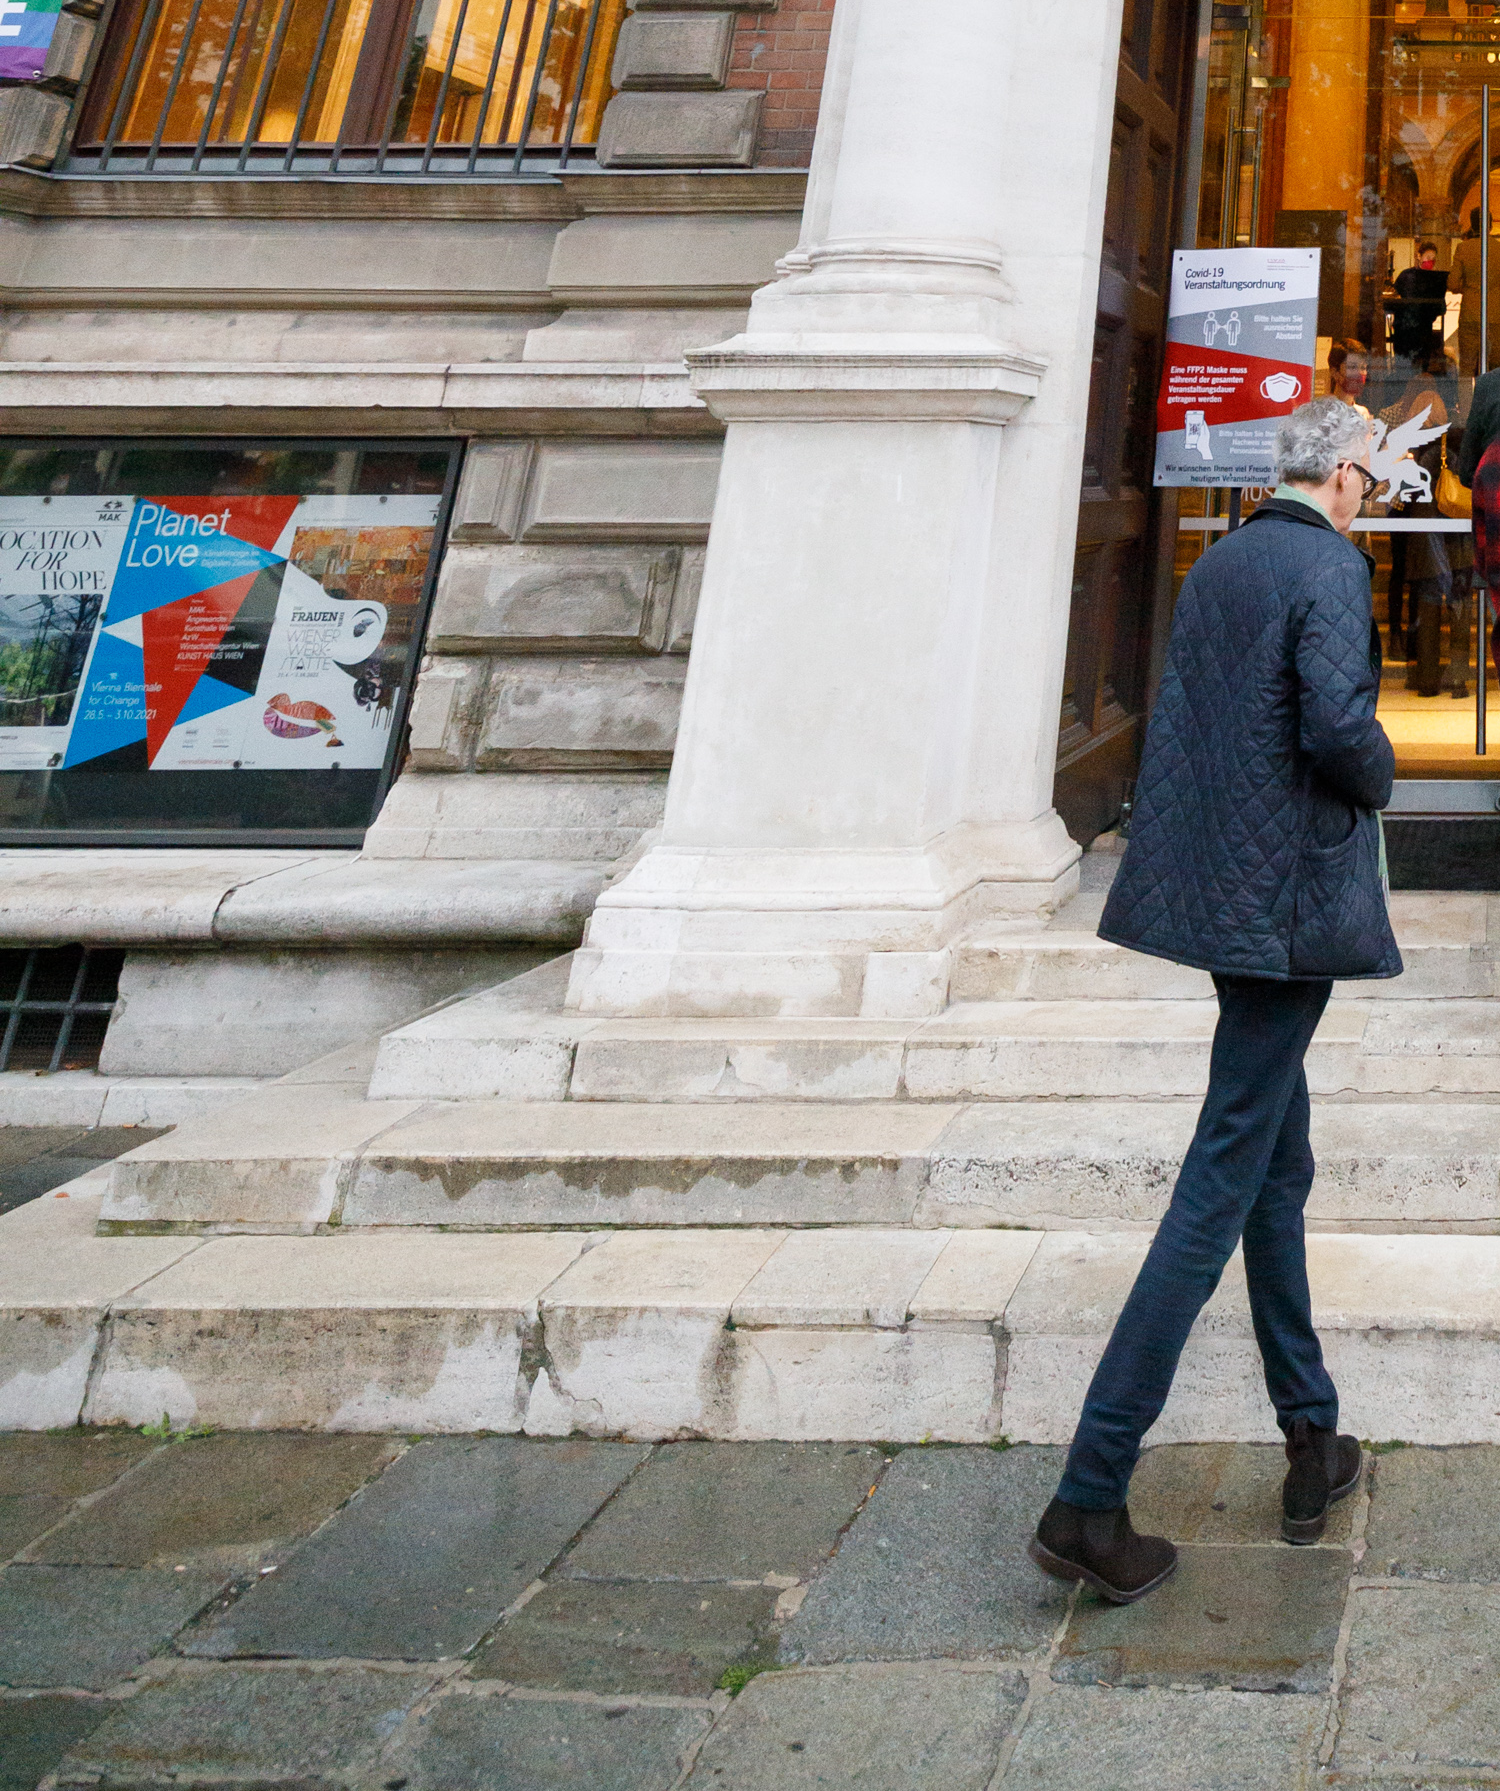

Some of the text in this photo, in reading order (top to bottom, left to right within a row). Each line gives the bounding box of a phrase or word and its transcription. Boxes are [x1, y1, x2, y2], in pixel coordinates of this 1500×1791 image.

[1185, 267, 1224, 278] Covid-19
[1184, 278, 1286, 292] Veranstaltungsordnung
[1275, 332, 1303, 340] Abstand
[1170, 366, 1185, 374] Eine
[1186, 366, 1205, 374] FFP2
[1206, 366, 1228, 374] Maske
[1211, 377, 1244, 385] gesamten
[1168, 386, 1236, 394] Veranstaltungsdauer
[1167, 396, 1196, 404] getragen
[1178, 464, 1212, 473] wünschen
[1190, 475, 1270, 484] heutigen Veranstaltung!
[98, 513, 121, 521] MAK
[134, 504, 231, 536] Planet
[0, 530, 106, 550] OCATION
[126, 538, 199, 567] Love
[16, 551, 68, 571] FOR
[42, 571, 107, 590] HOPE
[291, 611, 338, 622] FRAUEN
[287, 628, 341, 643] WIENER
[288, 642, 331, 656] WERK-
[177, 652, 244, 660] KUNST HAUS WIEN
[92, 682, 162, 692] Vienna Biennale
[88, 695, 140, 707] for Change
